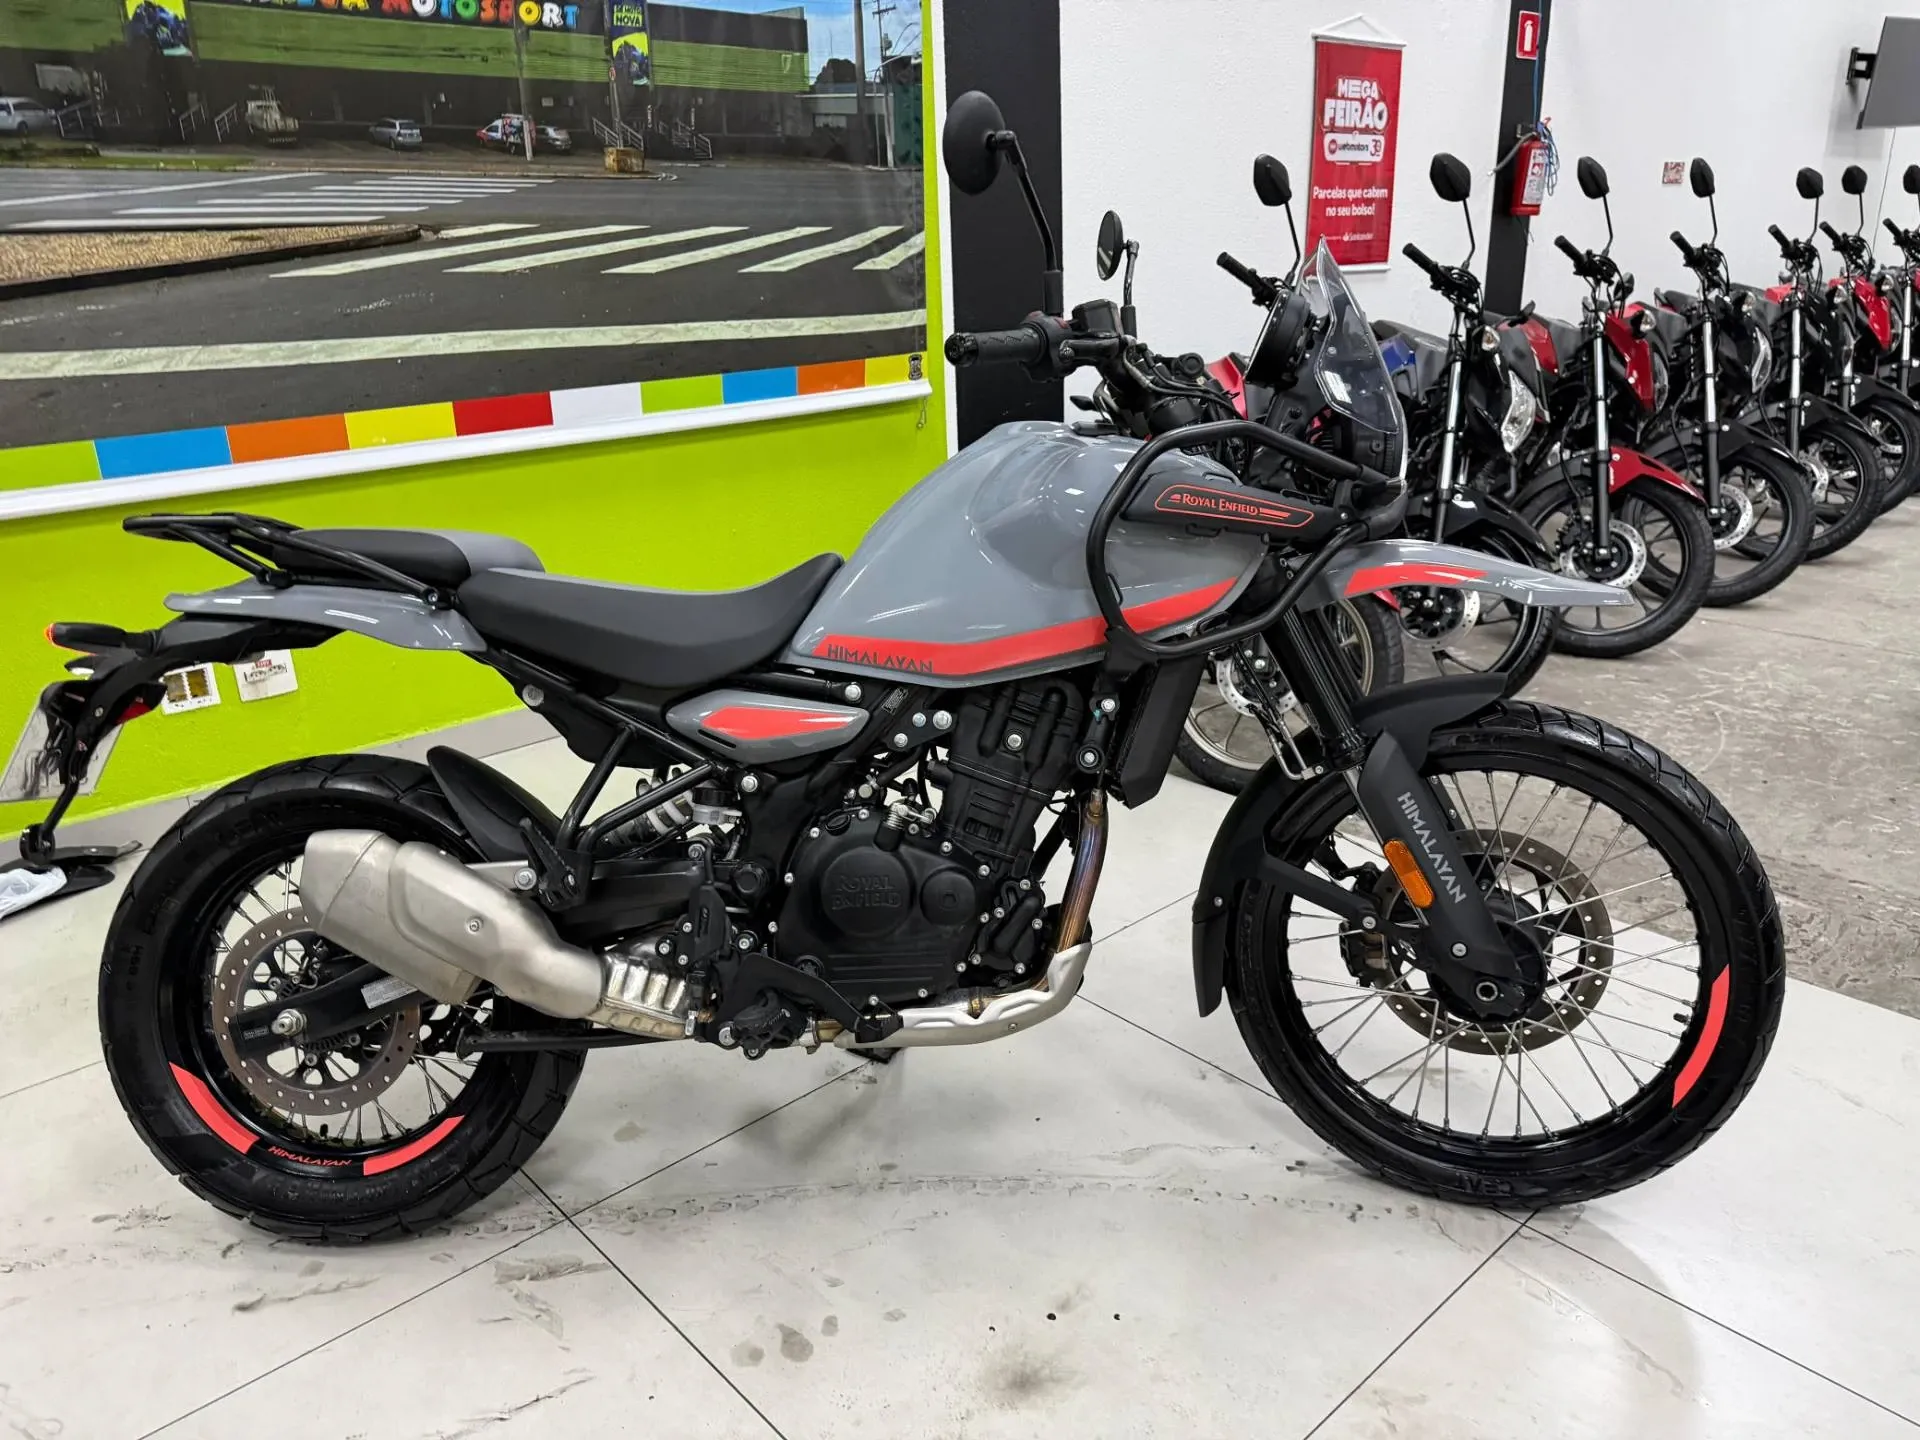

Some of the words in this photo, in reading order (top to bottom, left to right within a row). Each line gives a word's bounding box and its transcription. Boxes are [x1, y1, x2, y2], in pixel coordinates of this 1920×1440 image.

[616, 14, 641, 26] NOVA
[1337, 78, 1379, 100] MEGA
[1323, 97, 1388, 130] FEIRÃO
[1313, 186, 1346, 199] Parcelas
[1347, 189, 1362, 202] que
[1363, 186, 1388, 198] cabem
[1326, 206, 1337, 216] no
[1337, 205, 1351, 216] seu
[1352, 203, 1376, 216] bolso!
[1182, 493, 1217, 509] ROYAL
[1219, 499, 1259, 516] ENFIELD
[827, 643, 933, 673] HIMALAYAN
[1397, 791, 1467, 904] HIMALAYAN
[836, 874, 896, 892] ROYAL
[831, 891, 901, 911] ENFIELD
[267, 1145, 353, 1167] HIMALAYAN
